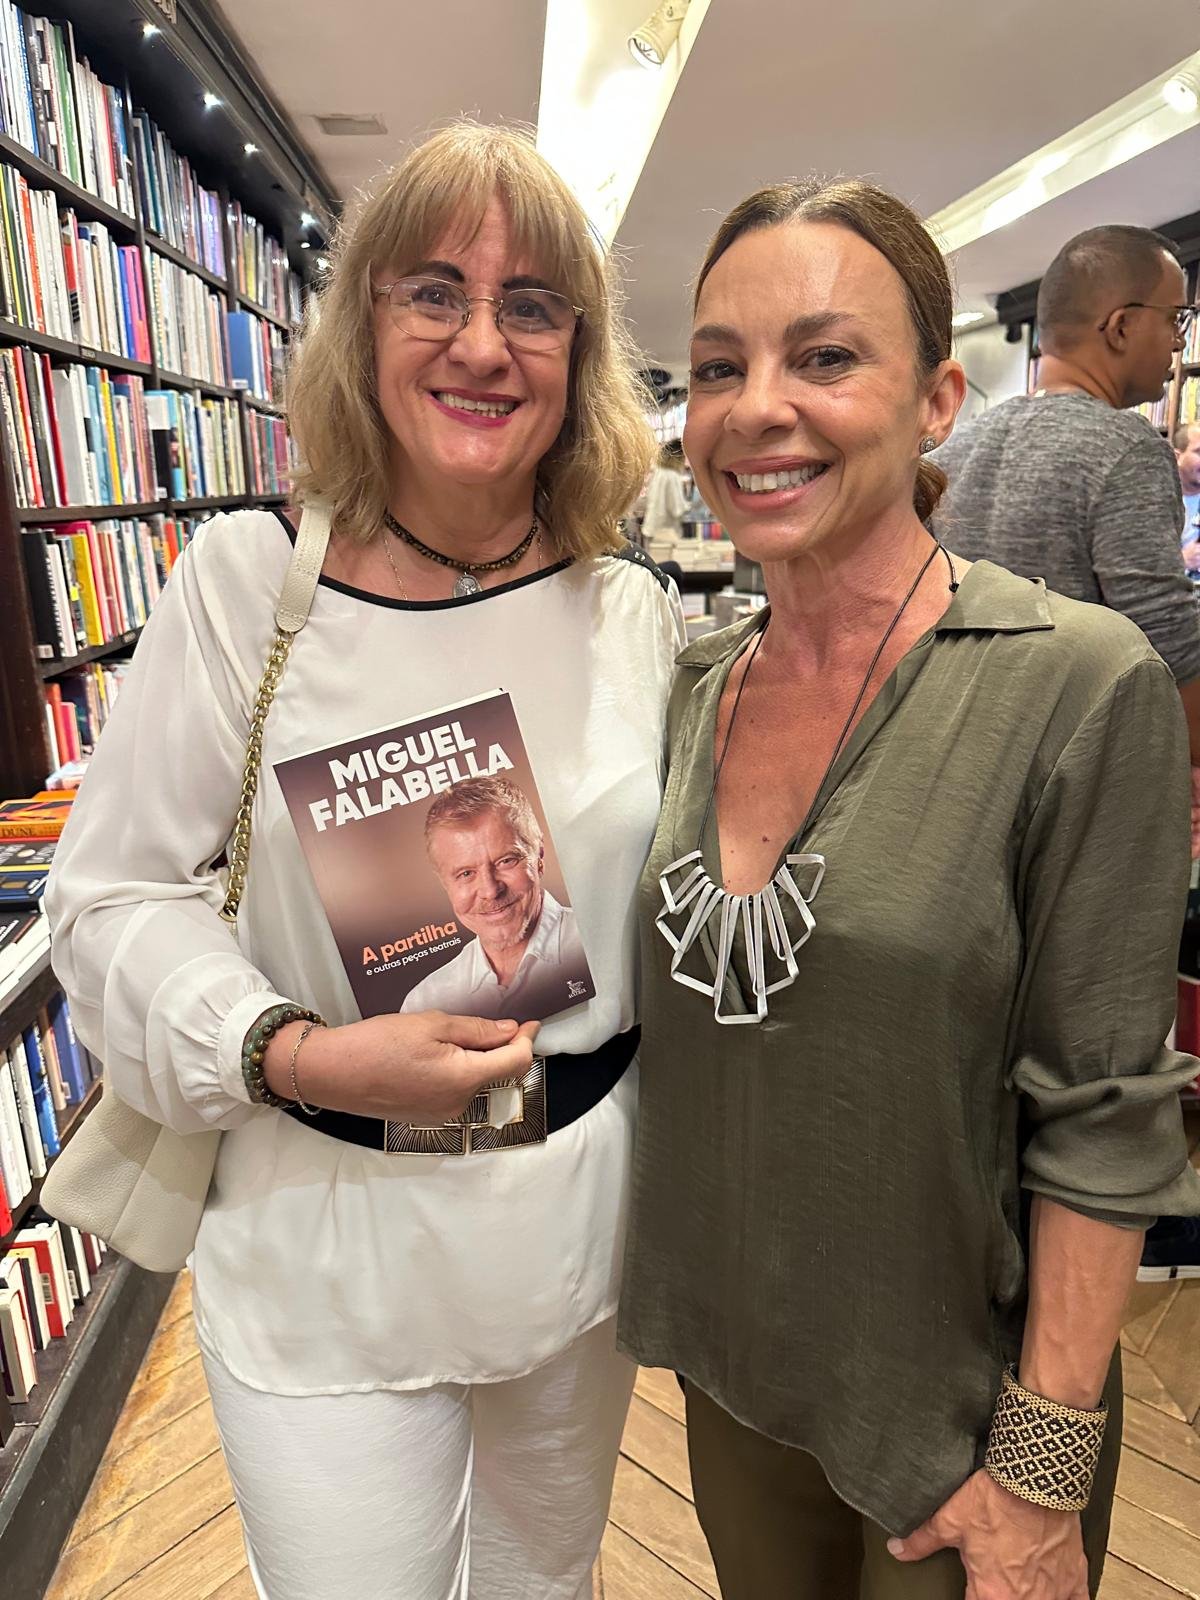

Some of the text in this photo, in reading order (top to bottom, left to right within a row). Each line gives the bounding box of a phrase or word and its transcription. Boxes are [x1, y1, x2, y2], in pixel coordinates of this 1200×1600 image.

[328, 721, 477, 790] MIGUEL
[308, 743, 515, 832] FALABELLA
[363, 921, 458, 965] A partilha
[373, 959, 401, 974] outras
[402, 948, 429, 966] peças
[428, 936, 461, 953] teatrais
